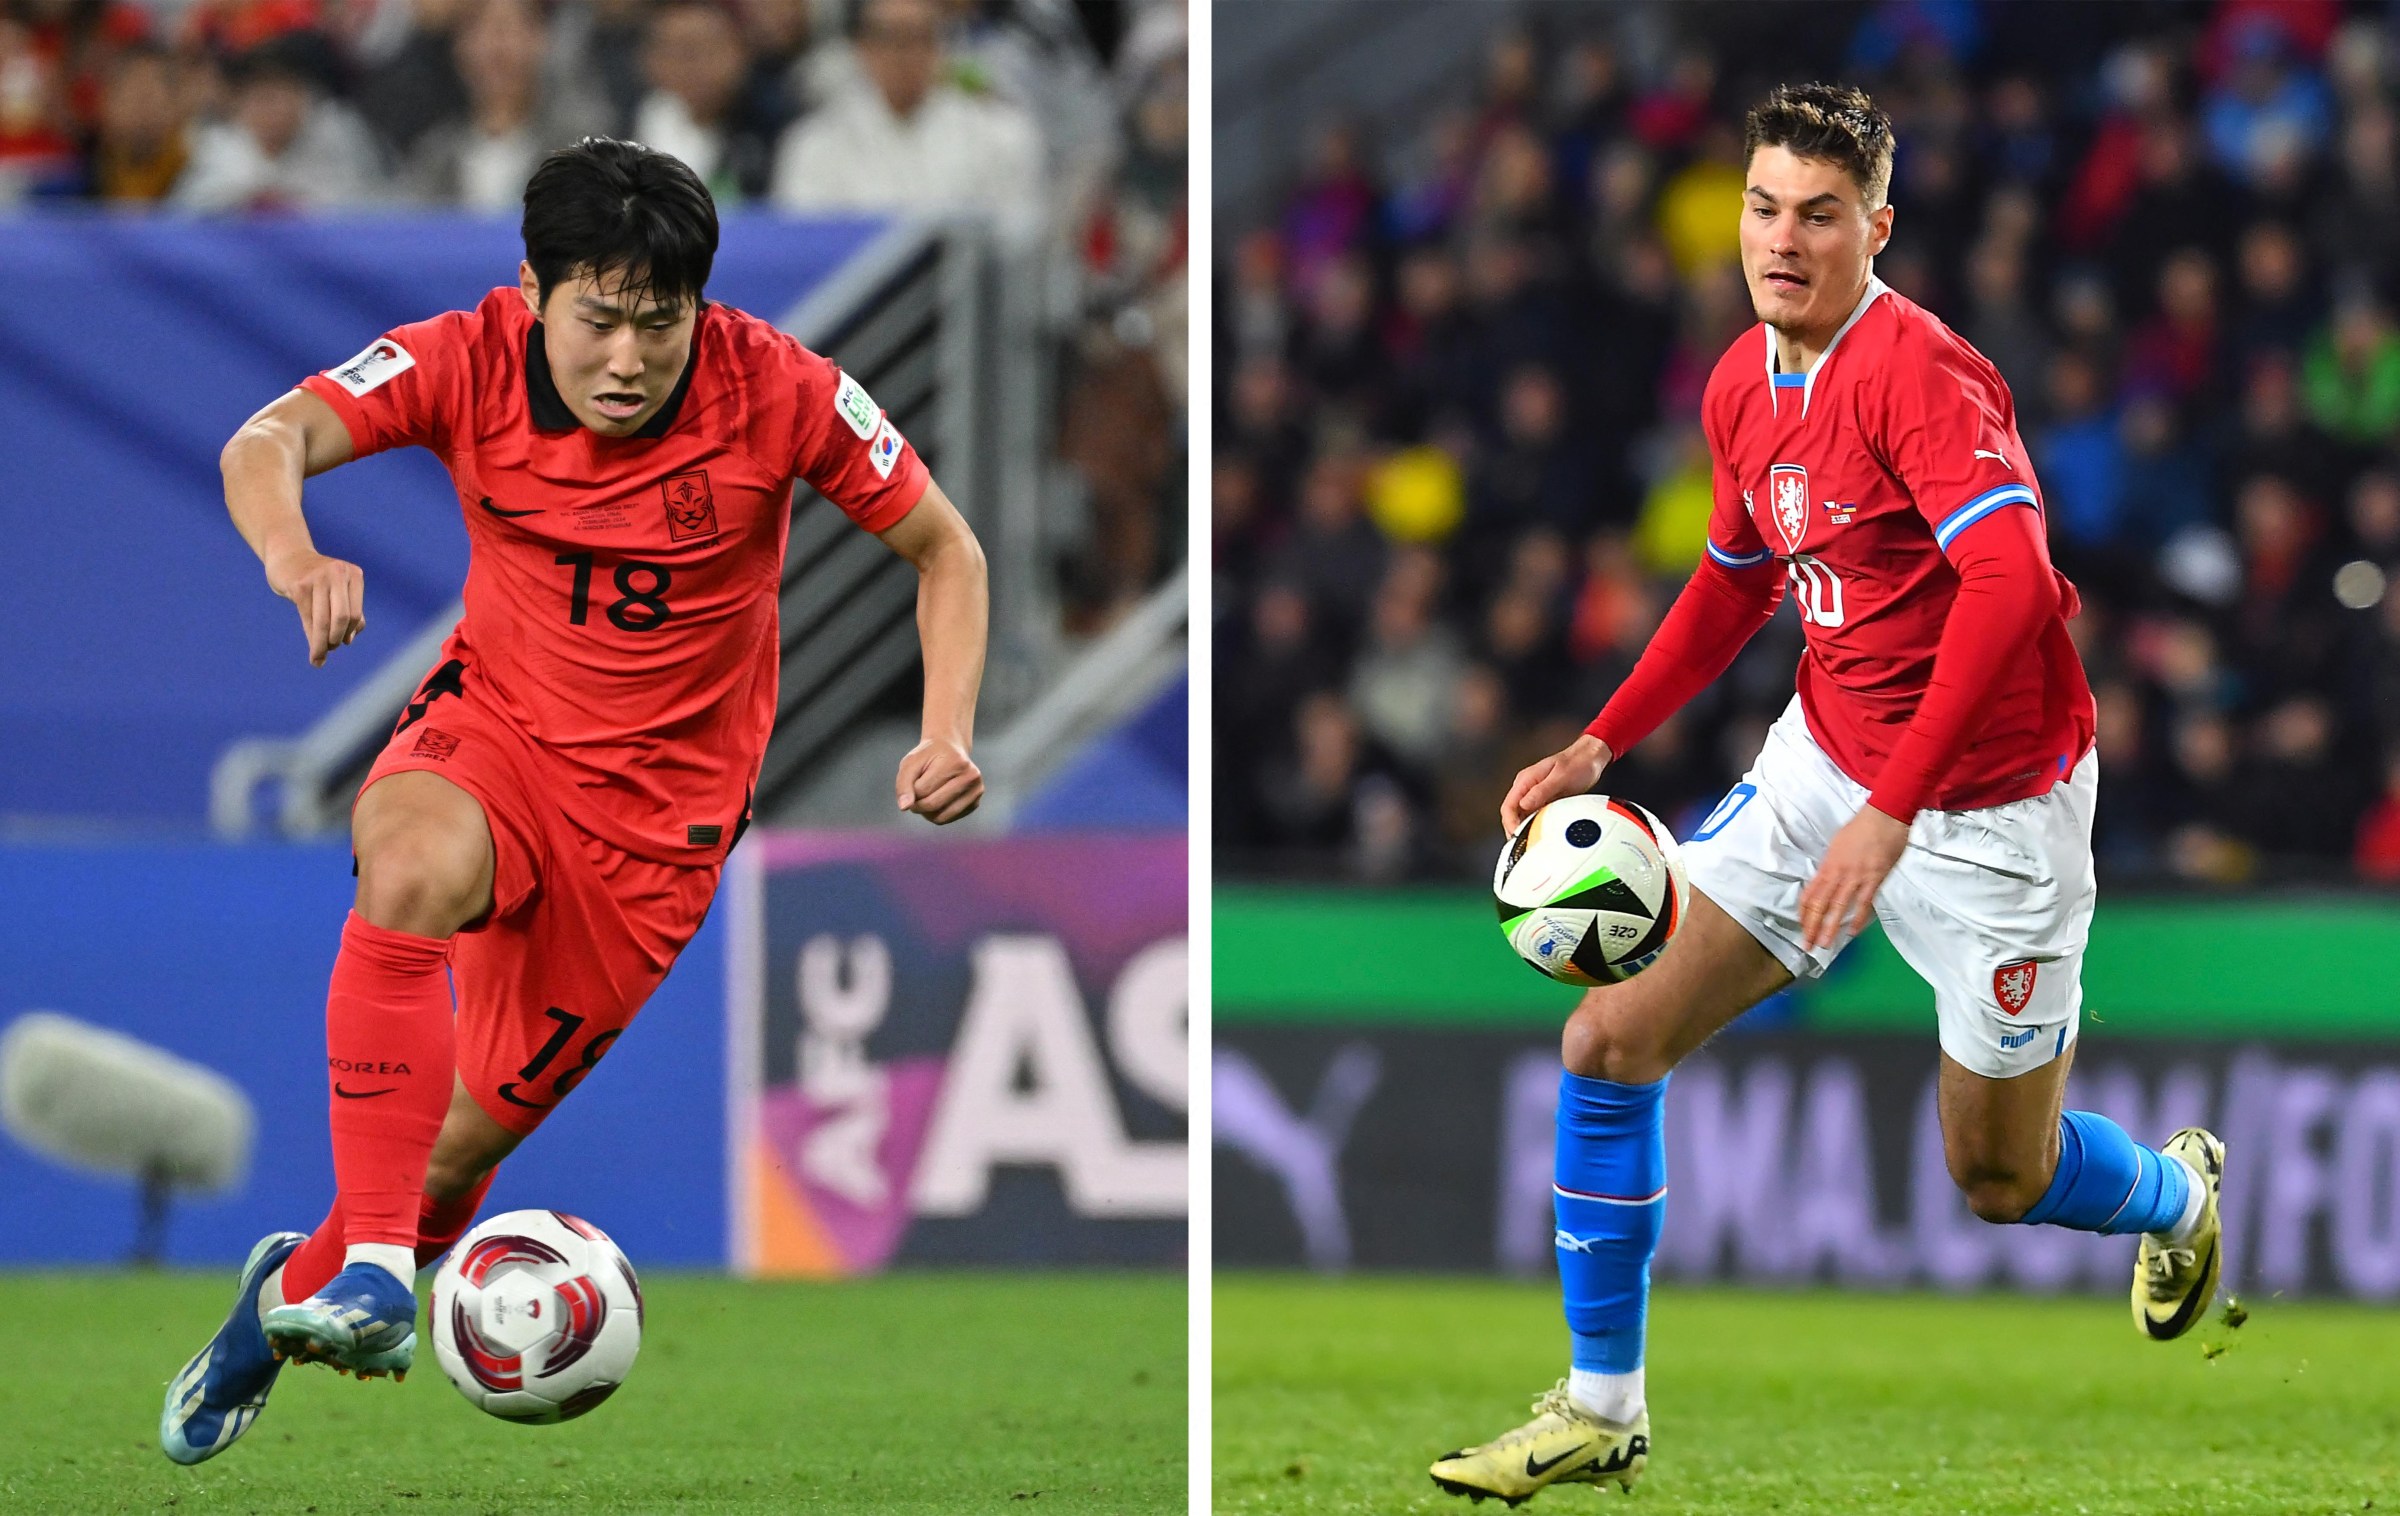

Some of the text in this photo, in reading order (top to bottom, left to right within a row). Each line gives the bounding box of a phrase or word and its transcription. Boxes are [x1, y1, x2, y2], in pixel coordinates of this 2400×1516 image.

[555, 551, 672, 633] 18
[1608, 924, 1639, 939] CZE
[2000, 1028, 2035, 1049] PUMA
[328, 1057, 412, 1076] KOREA
[797, 932, 893, 1212] AFC
